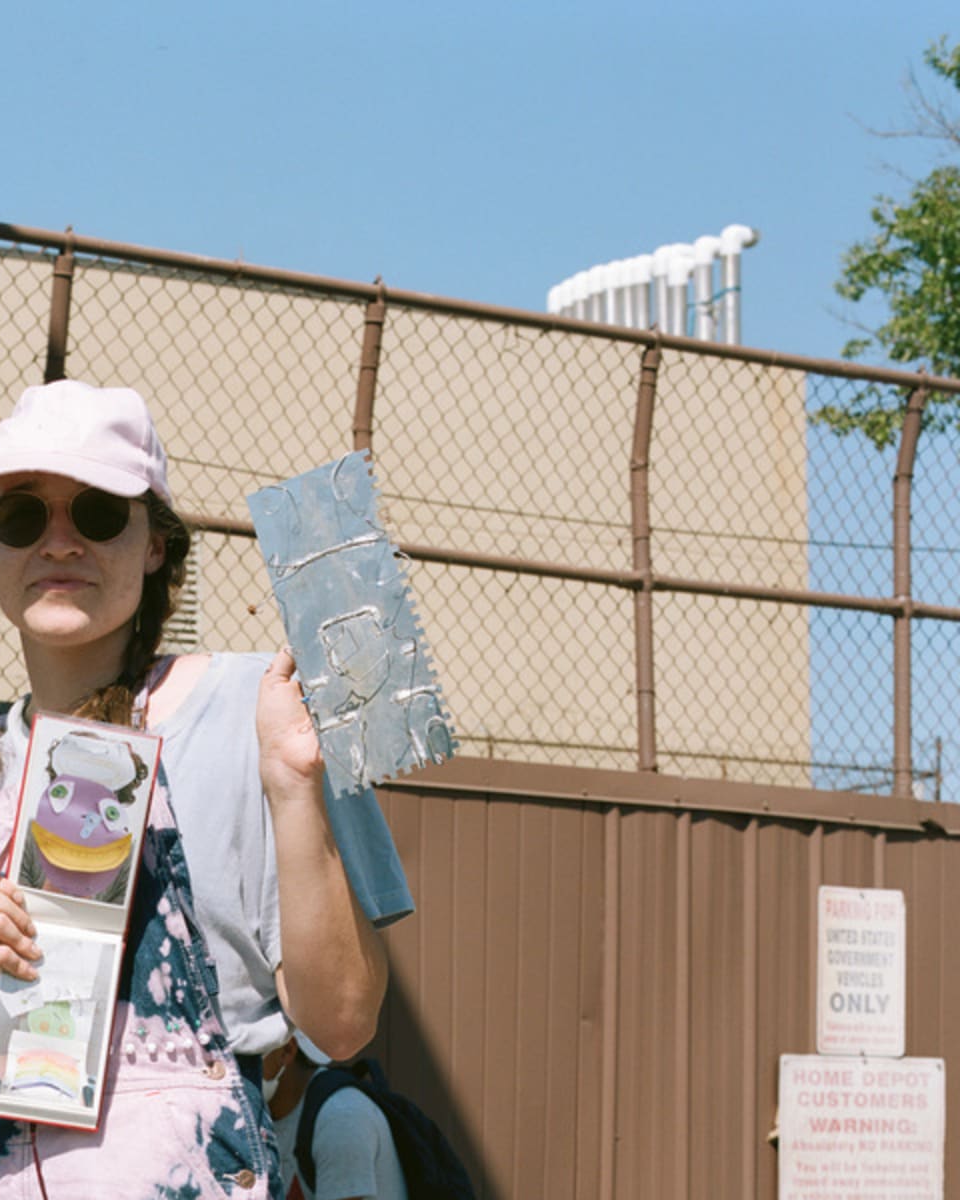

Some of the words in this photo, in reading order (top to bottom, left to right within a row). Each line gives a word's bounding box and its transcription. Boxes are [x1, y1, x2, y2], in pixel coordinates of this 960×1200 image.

[829, 991, 891, 1014] ONLY
[792, 1069, 854, 1087] HOME
[862, 1071, 931, 1088] DEPOT
[797, 1091, 929, 1109] CUSTOMERS
[809, 1117, 918, 1134] WARNING:
